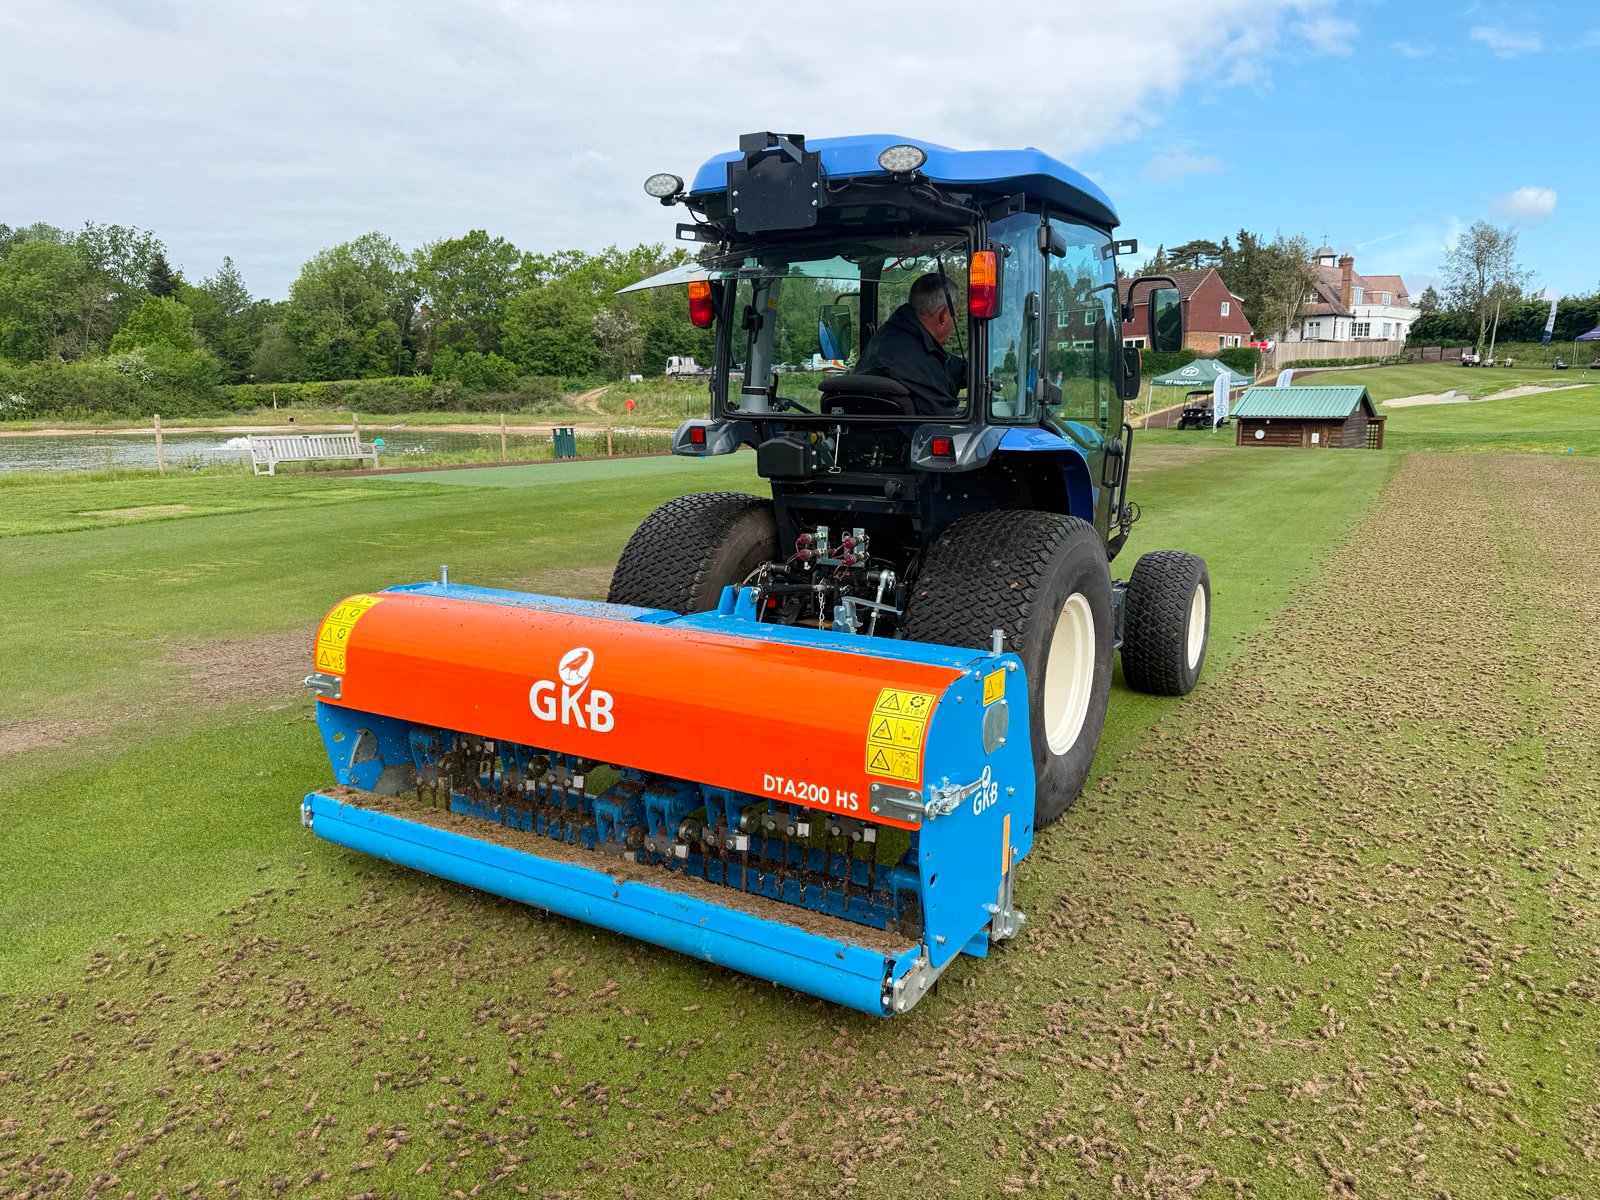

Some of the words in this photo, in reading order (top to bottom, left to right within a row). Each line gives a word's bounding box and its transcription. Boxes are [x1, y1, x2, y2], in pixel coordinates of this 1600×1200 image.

[529, 678, 615, 733] GKB
[904, 707, 925, 716] STOP
[763, 774, 830, 805] DTA200
[836, 790, 859, 811] HS
[973, 781, 998, 816] GKB
